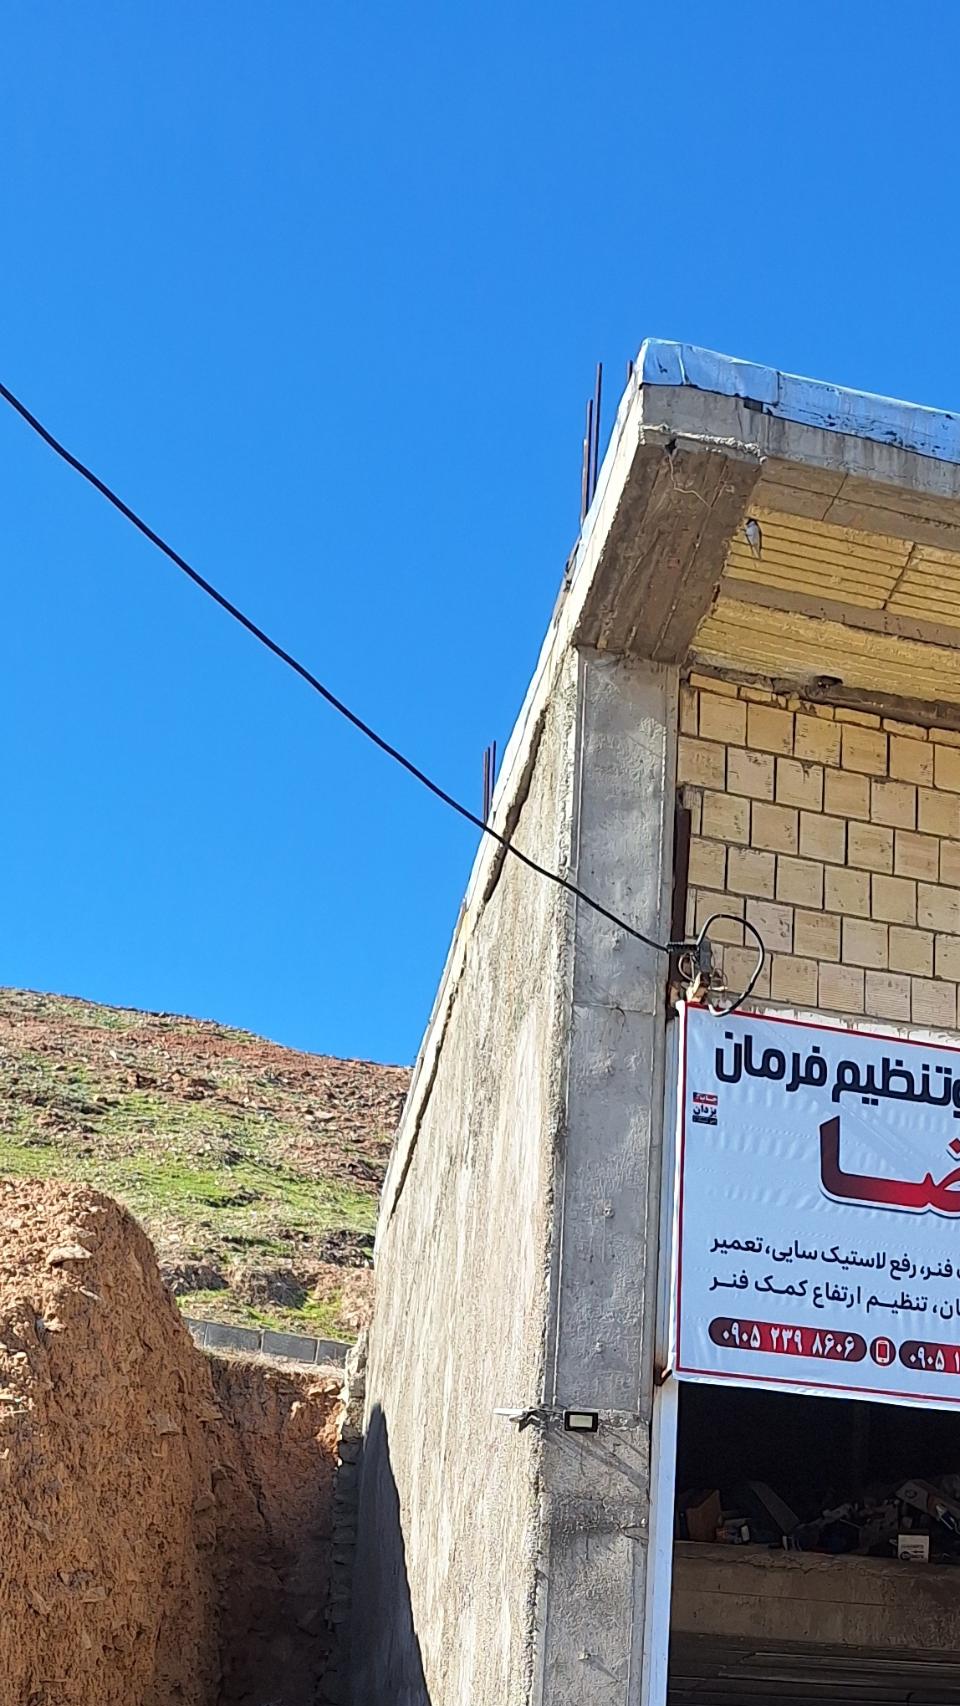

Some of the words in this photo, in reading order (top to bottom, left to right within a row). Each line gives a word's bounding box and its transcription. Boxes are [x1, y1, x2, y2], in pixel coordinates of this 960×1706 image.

[715, 1031, 828, 1092] فرمان
[710, 1236, 763, 1255] تعمیر
[821, 1246, 886, 1271] لاستیک
[889, 1252, 917, 1280] رفع
[709, 1269, 749, 1291] فنر
[754, 1275, 809, 1297] کمک
[812, 1281, 861, 1309] ارتفاع
[866, 1291, 928, 1313] تنظیم
[722, 1321, 761, 1348] ۰۹۰۵
[770, 1326, 803, 1353] ۲۳۹
[812, 1331, 855, 1359] ۸۶۰۶
[909, 1346, 945, 1371] ۰۹۰۵
